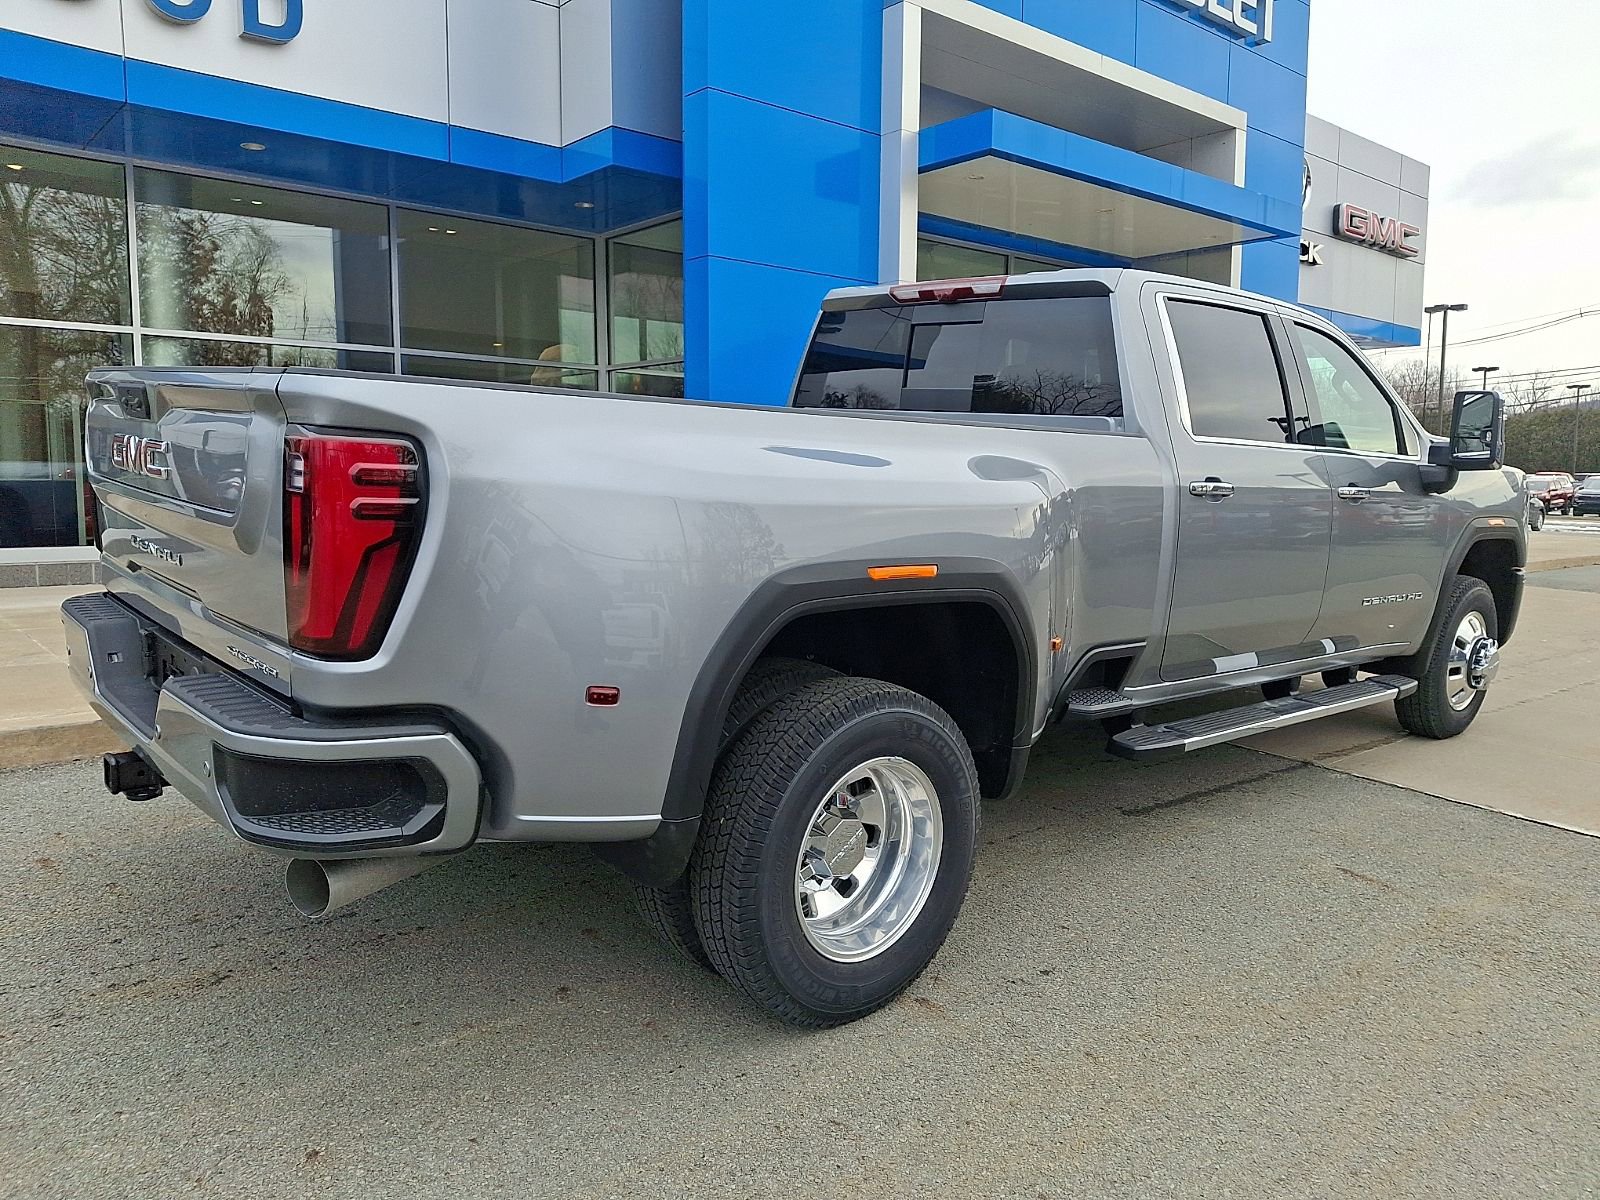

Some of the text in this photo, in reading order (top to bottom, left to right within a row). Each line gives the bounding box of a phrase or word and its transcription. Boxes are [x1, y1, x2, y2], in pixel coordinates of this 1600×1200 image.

[1337, 203, 1420, 257] GMC
[112, 433, 172, 480] GMC
[130, 534, 184, 567] DENALI
[1362, 591, 1423, 606] DENALI HD
